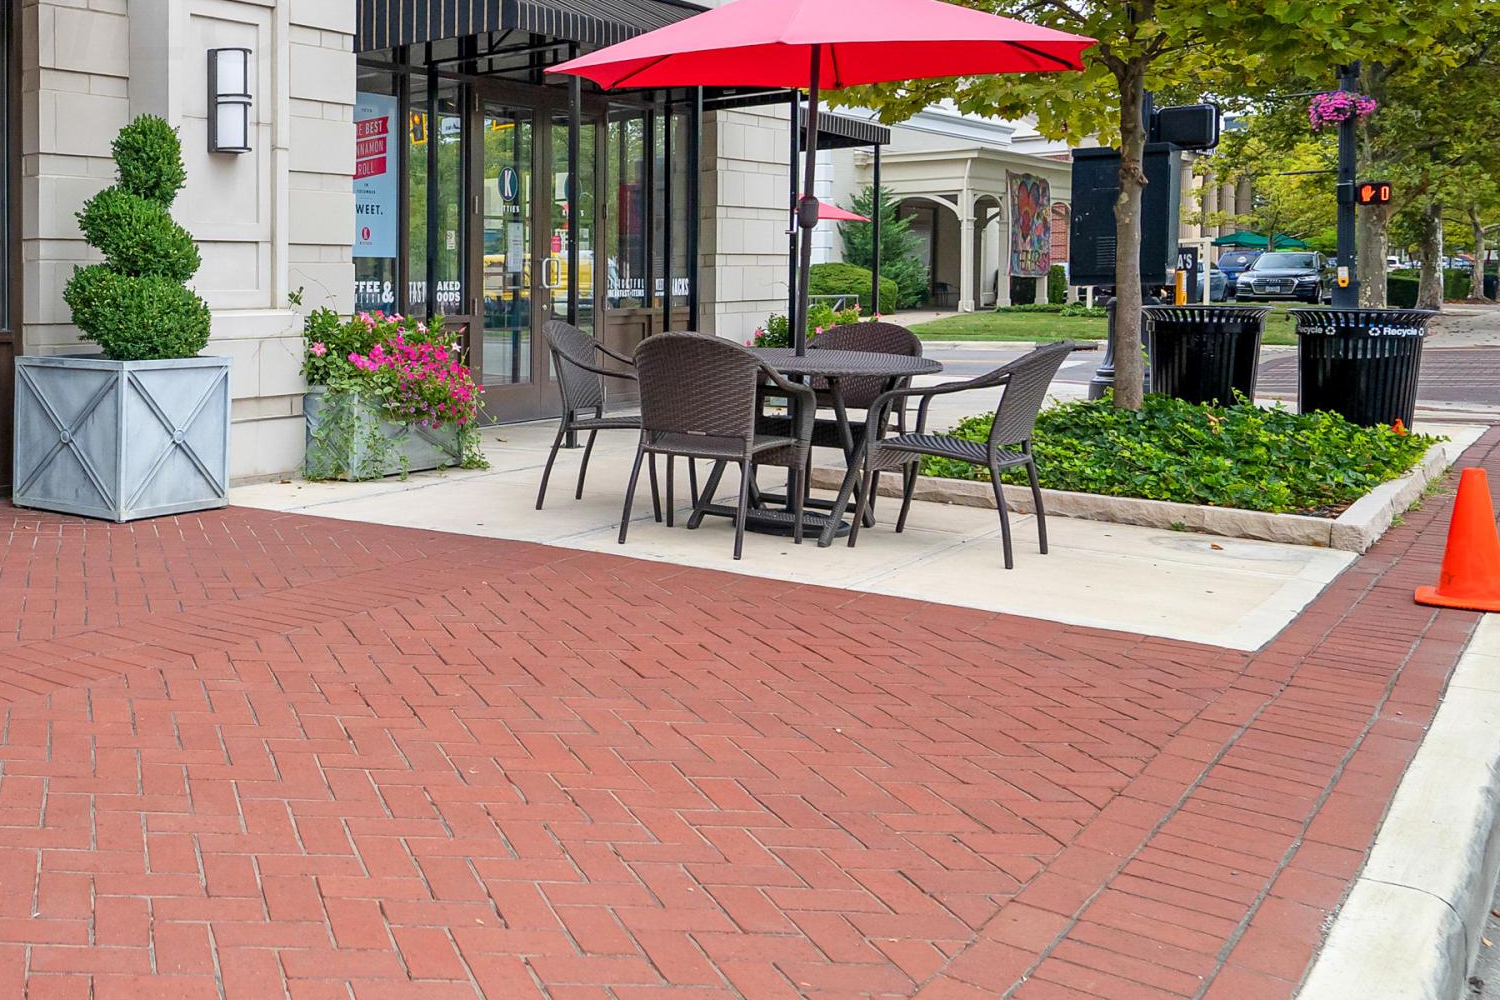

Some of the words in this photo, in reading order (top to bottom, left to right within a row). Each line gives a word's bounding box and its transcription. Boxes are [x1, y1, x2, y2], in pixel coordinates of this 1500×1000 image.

[365, 120, 383, 134] BEST
[357, 164, 374, 176] ROLL
[1380, 185, 1390, 201] 0
[356, 204, 383, 215] WEET.
[436, 280, 460, 291] AKED
[354, 281, 380, 292] FFEE
[381, 281, 394, 303] &
[436, 291, 460, 302] OODS
[1383, 327, 1418, 337] Recycle
